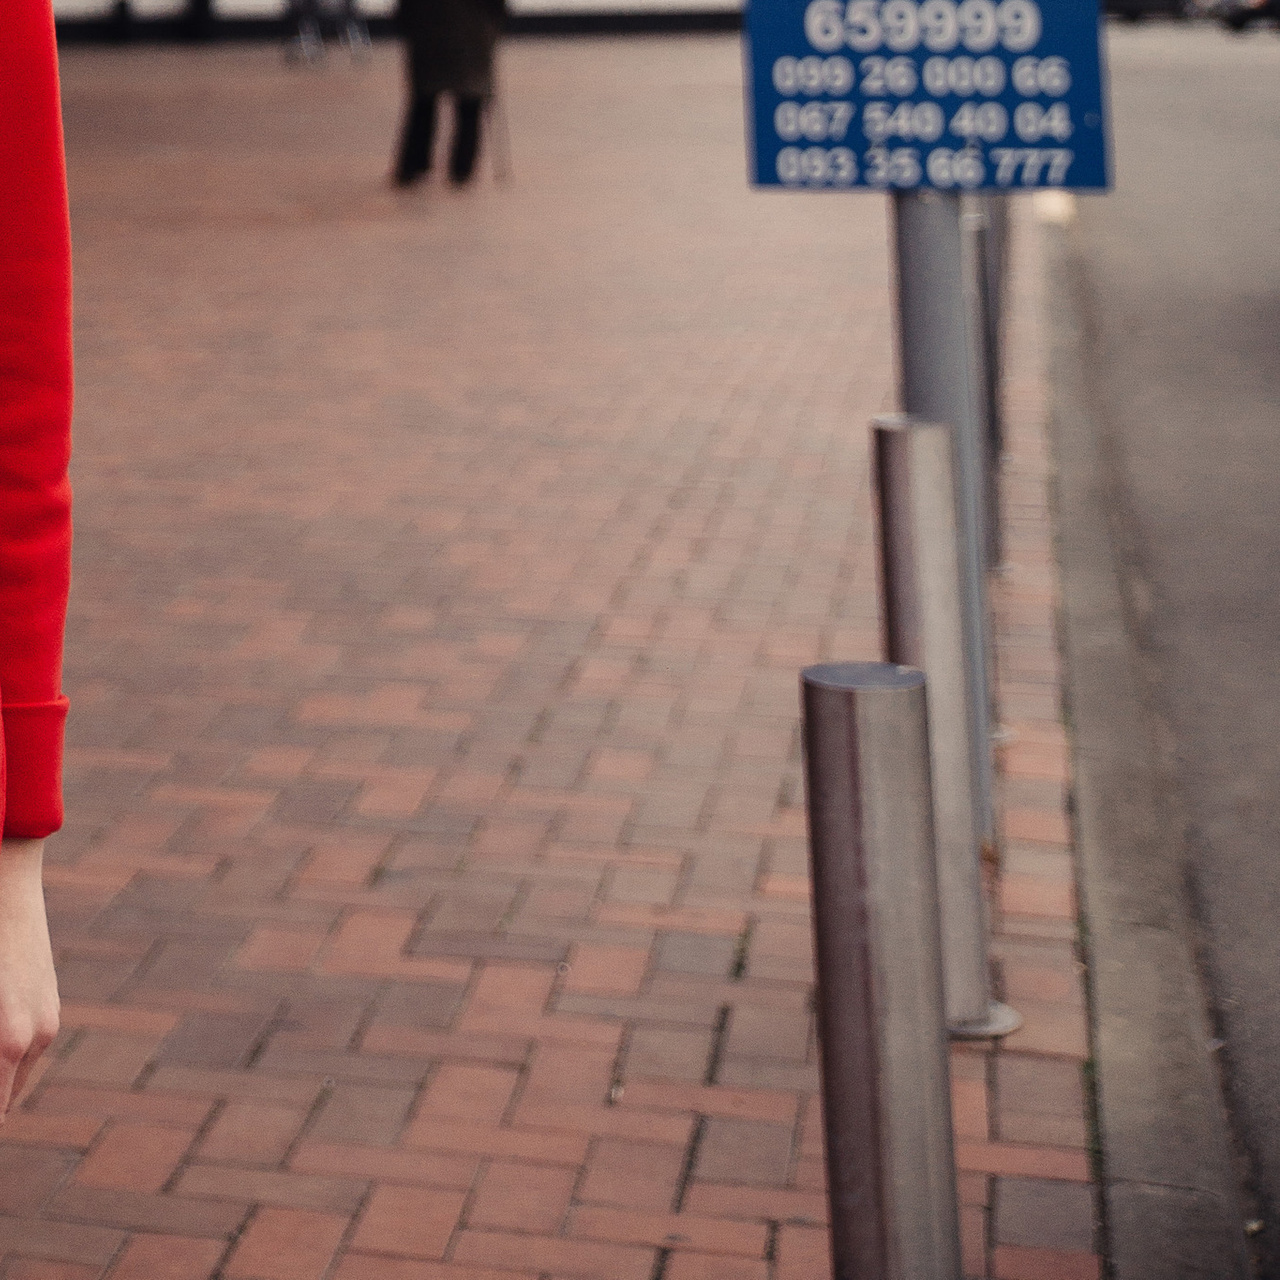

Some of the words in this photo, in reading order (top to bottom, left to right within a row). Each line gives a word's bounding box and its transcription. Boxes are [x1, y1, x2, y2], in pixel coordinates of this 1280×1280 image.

[859, 55, 919, 97] 26
[774, 101, 857, 143] 067
[949, 101, 1010, 144] 40
[862, 146, 923, 188] 35
[988, 147, 1075, 188] 777
